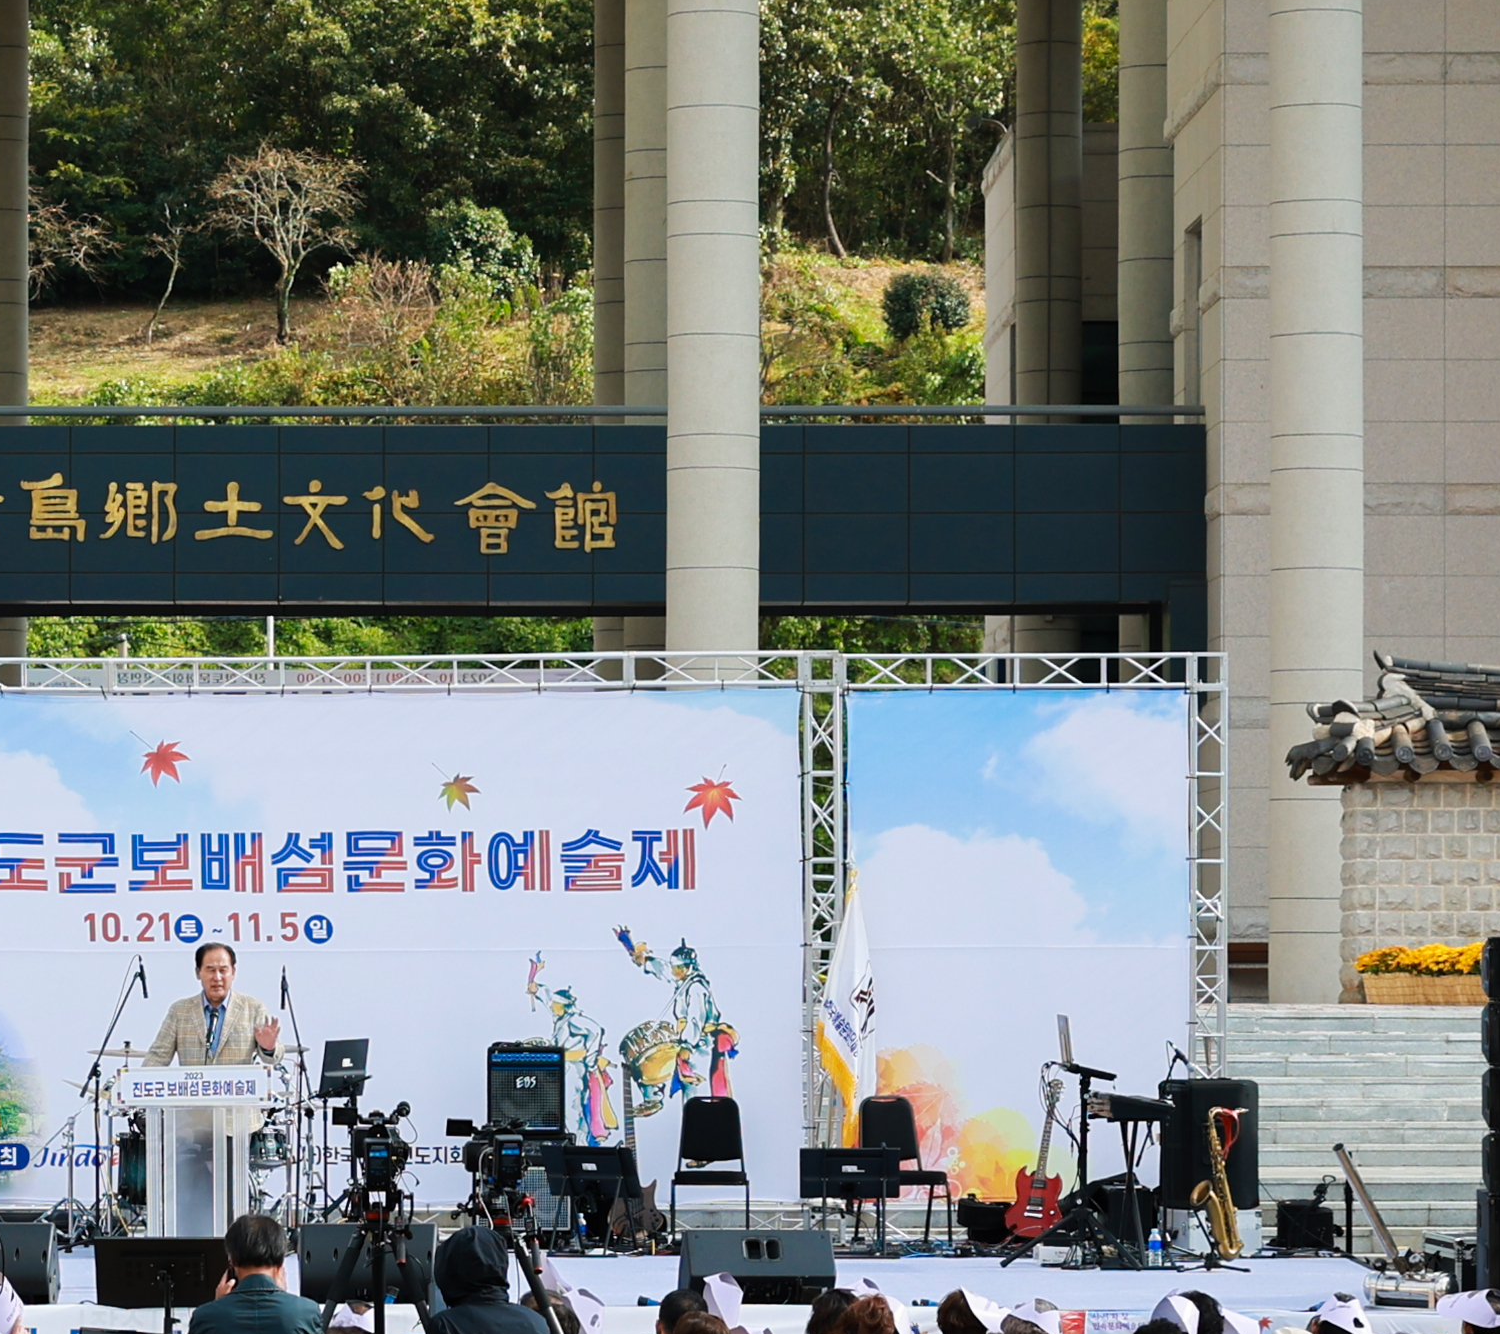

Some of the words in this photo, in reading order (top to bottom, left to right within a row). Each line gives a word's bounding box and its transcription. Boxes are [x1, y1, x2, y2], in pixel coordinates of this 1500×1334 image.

[184, 1072, 204, 1080] 2023
[515, 1076, 537, 1089] EBS
[132, 1080, 164, 1098] 진도군
[167, 1080, 200, 1098] 보배섬
[201, 1079, 257, 1097] 문화예술제
